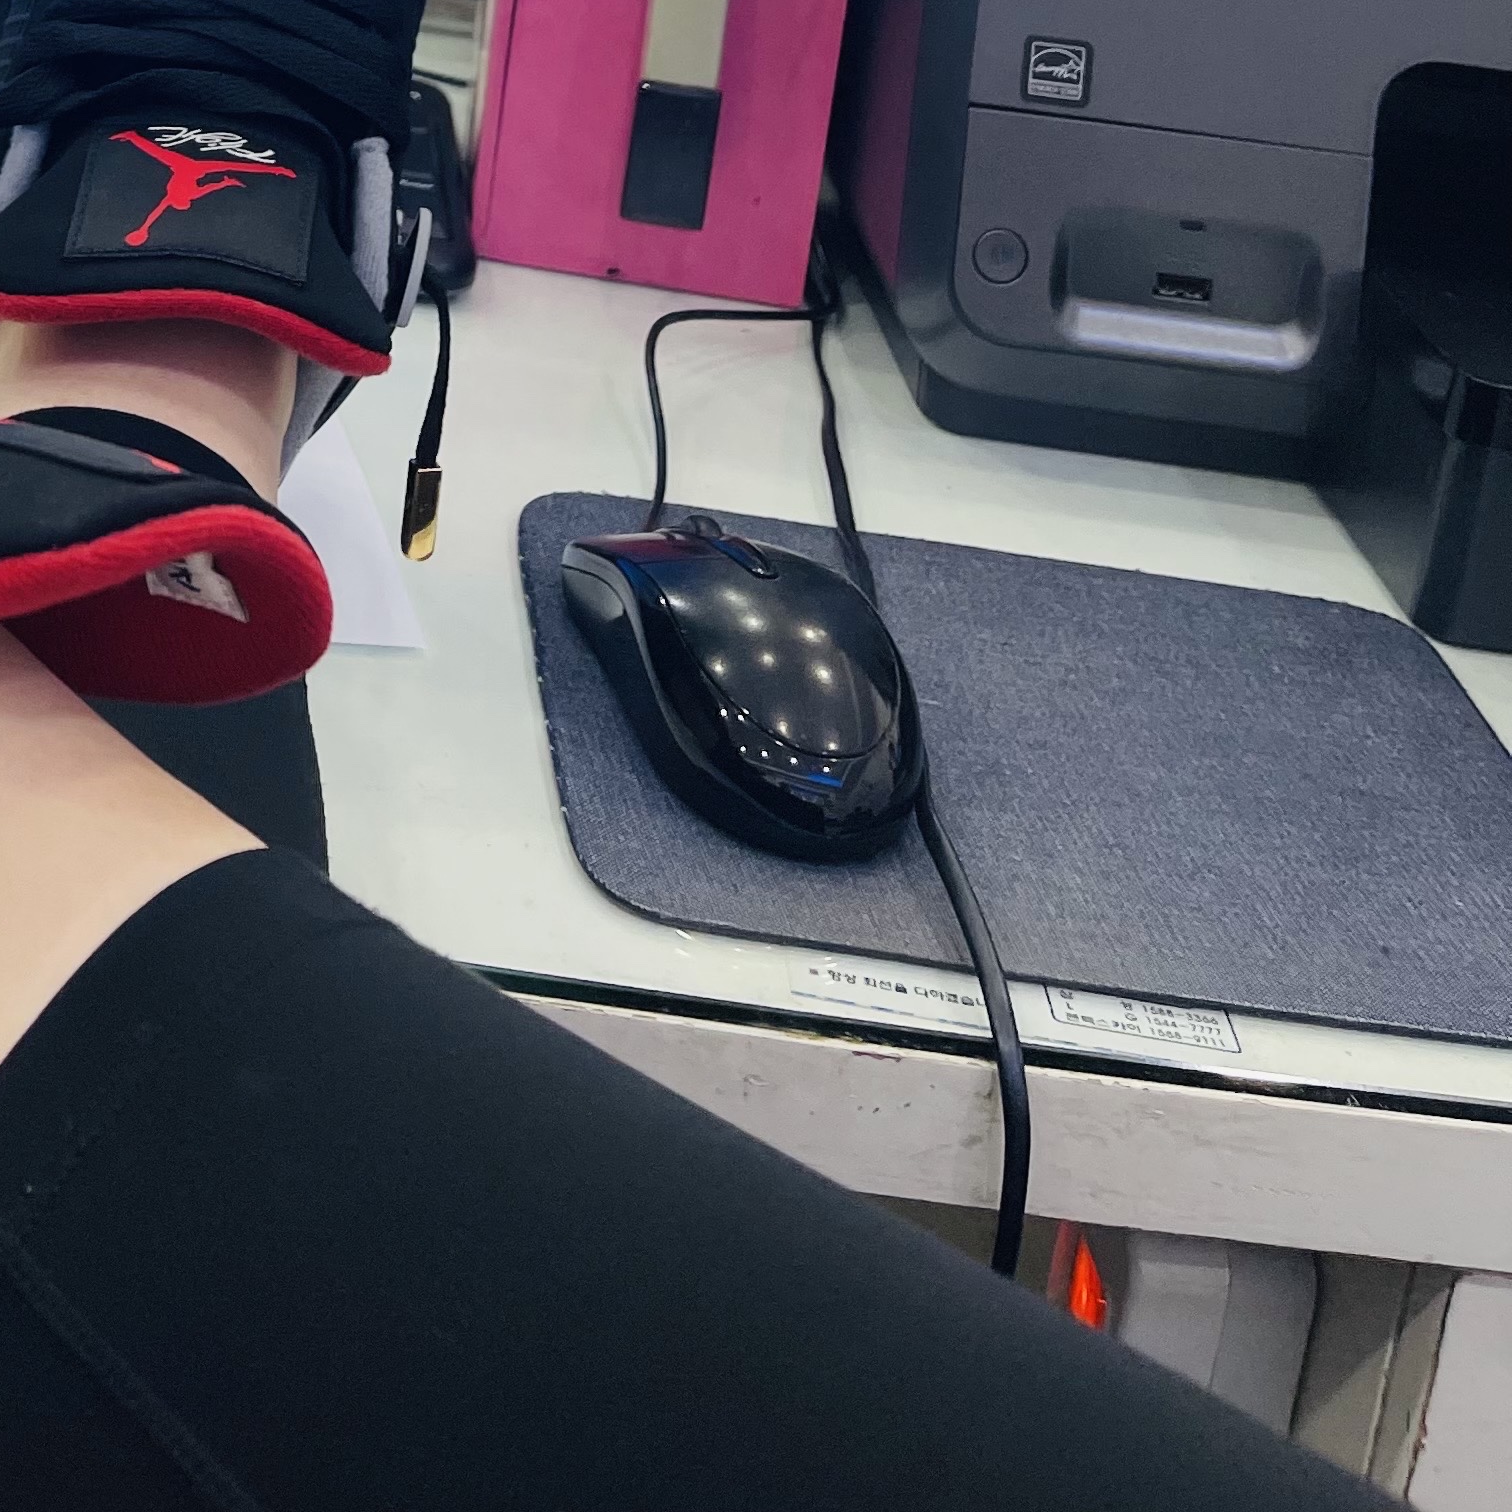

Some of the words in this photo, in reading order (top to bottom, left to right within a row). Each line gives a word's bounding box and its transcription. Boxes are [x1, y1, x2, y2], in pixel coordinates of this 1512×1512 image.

[827, 969, 857, 985] 항상
[863, 976, 908, 995] 최선을
[1146, 1015, 1221, 1036] 1544-7777
